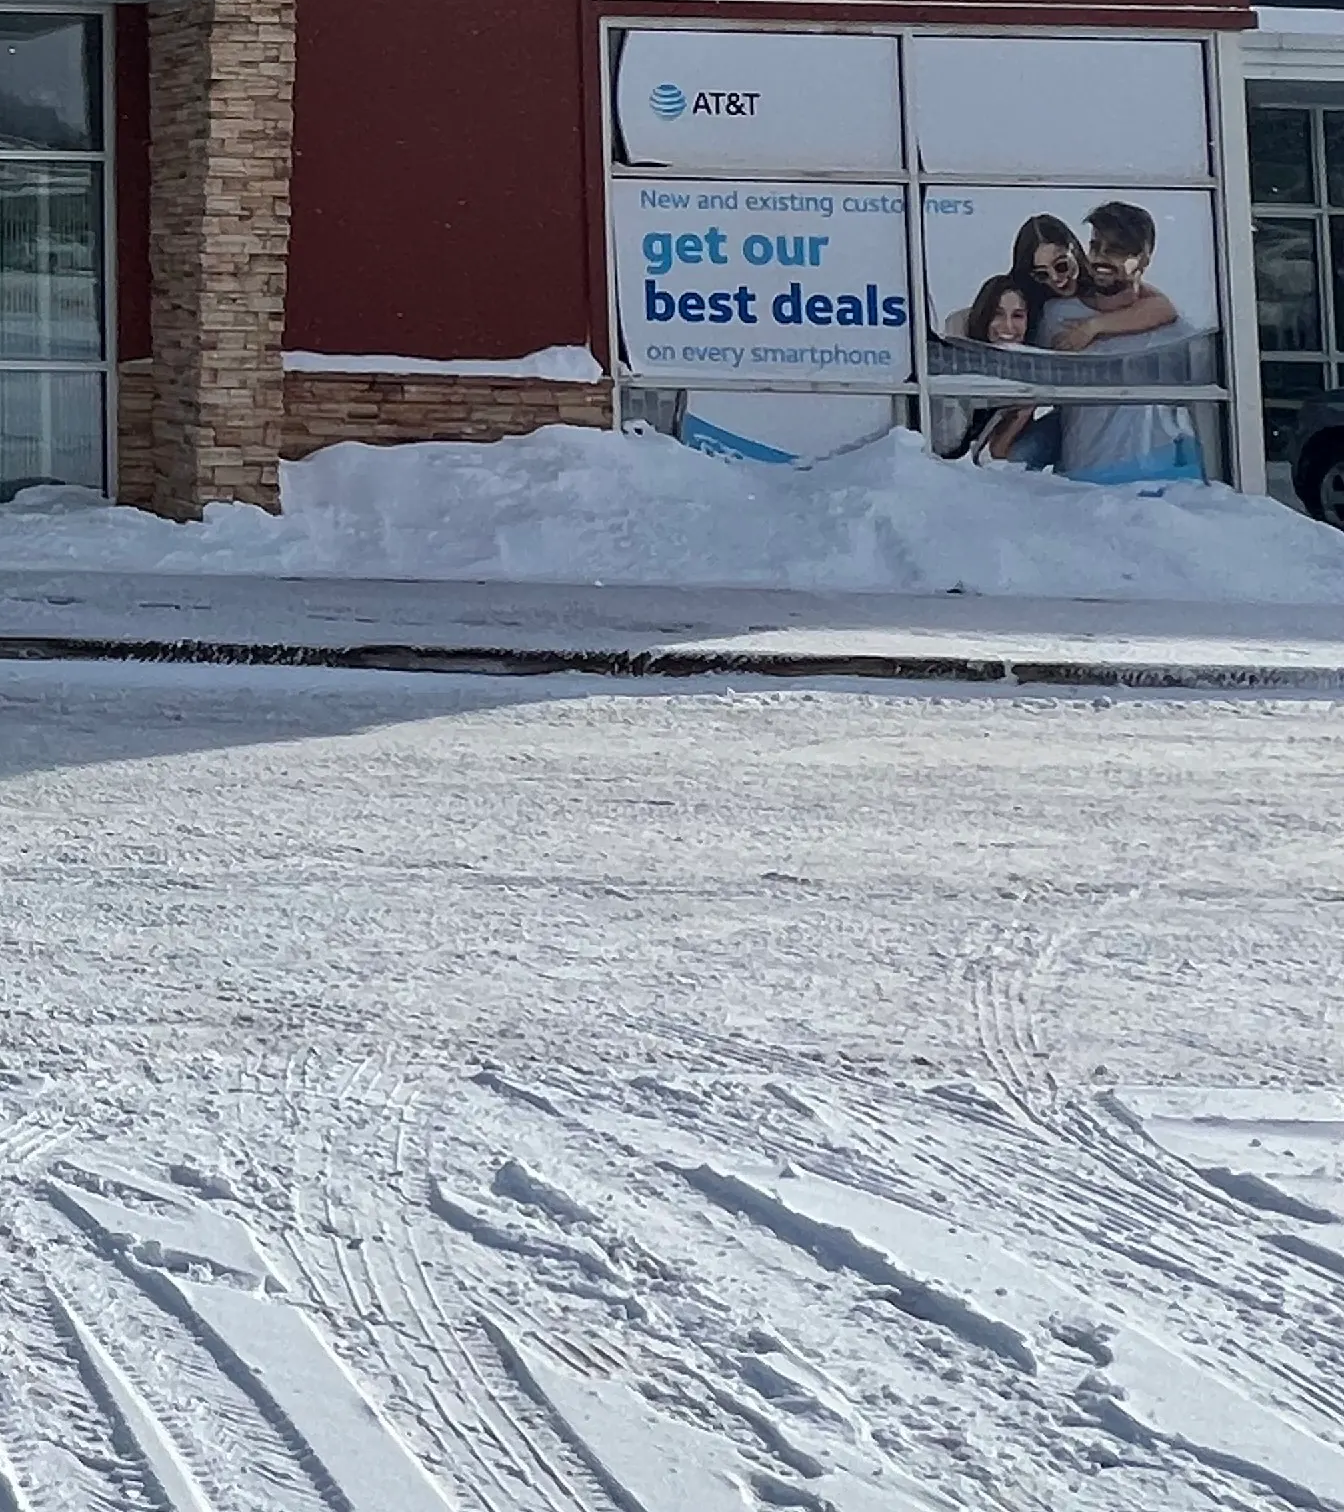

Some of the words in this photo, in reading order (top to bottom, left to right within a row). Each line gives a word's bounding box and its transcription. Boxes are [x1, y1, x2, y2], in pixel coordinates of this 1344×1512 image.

[692, 92, 761, 117] AT&T
[640, 191, 690, 210] New
[698, 191, 738, 210] and
[746, 192, 834, 218] existing
[642, 227, 728, 275] get
[742, 235, 830, 268] our
[645, 280, 758, 324] best
[772, 282, 907, 327] deals
[646, 344, 676, 361] on
[682, 346, 744, 368] every
[750, 344, 893, 368] smartphone
